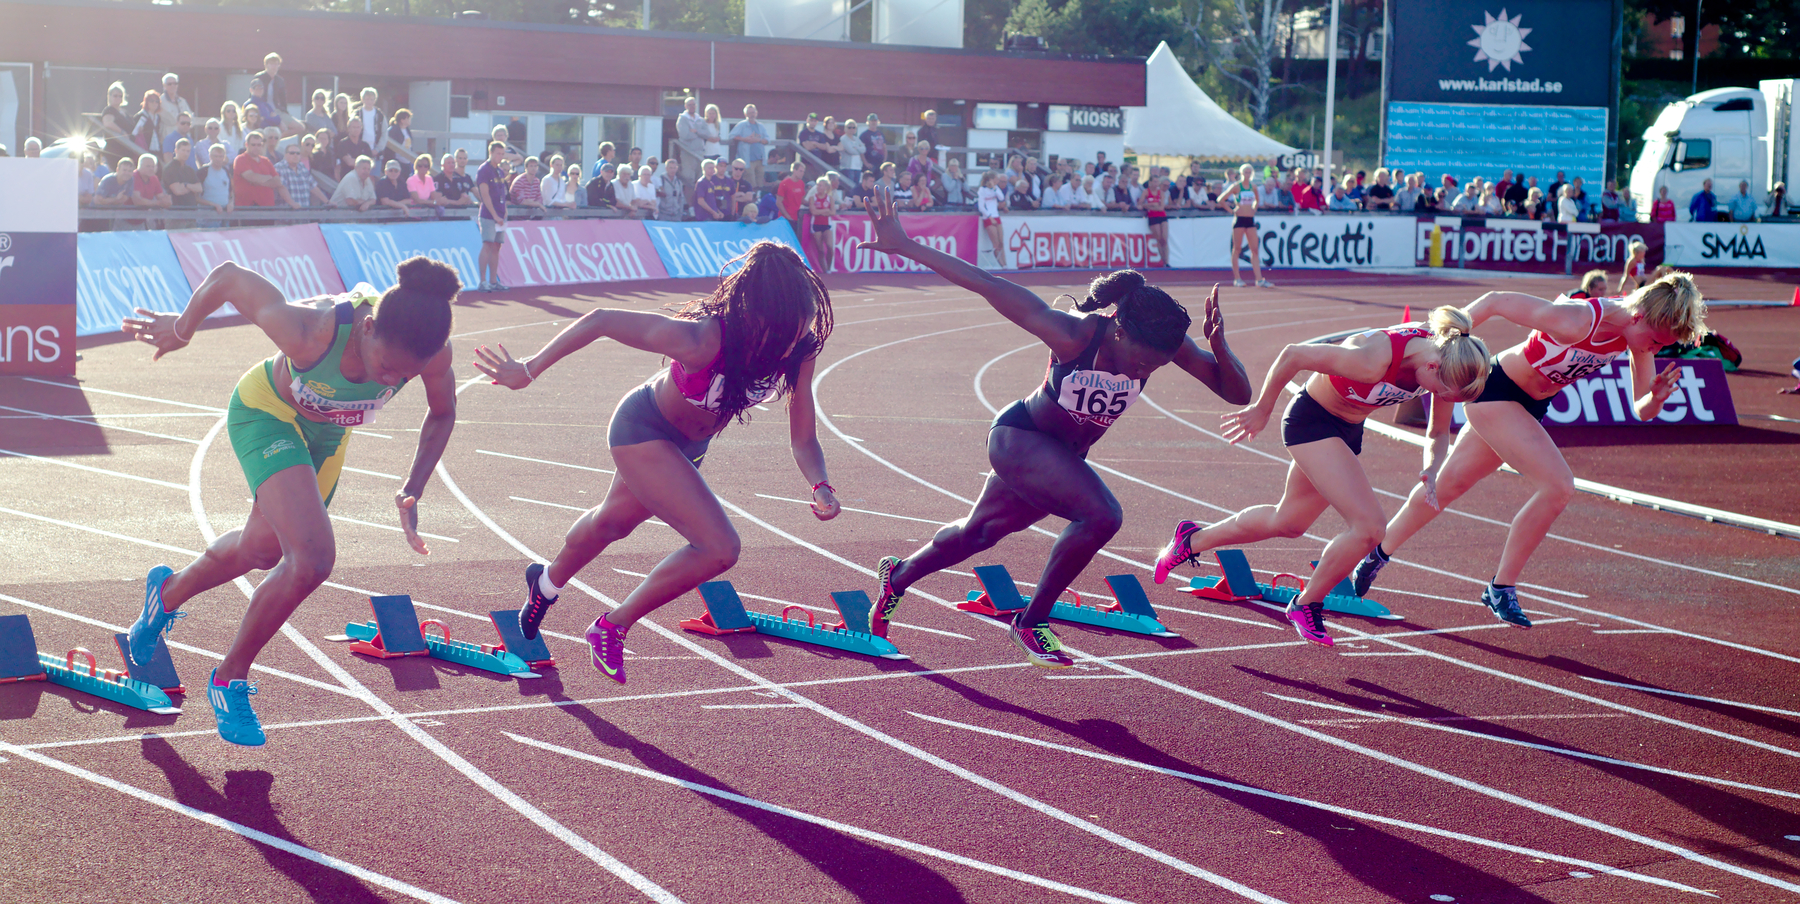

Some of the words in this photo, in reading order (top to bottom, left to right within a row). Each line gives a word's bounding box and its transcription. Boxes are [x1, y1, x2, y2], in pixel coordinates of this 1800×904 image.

[1438, 77, 1563, 93] www.karlstad.se
[1072, 110, 1121, 129] KIOSK
[1281, 153, 1337, 170] GRIL
[506, 226, 651, 285] Folksam
[652, 226, 783, 276] Folks
[1034, 233, 1163, 266] BAUHAUS
[1551, 229, 1645, 262] Finan
[1070, 372, 1135, 392] Folksam
[1072, 387, 1129, 415] 165
